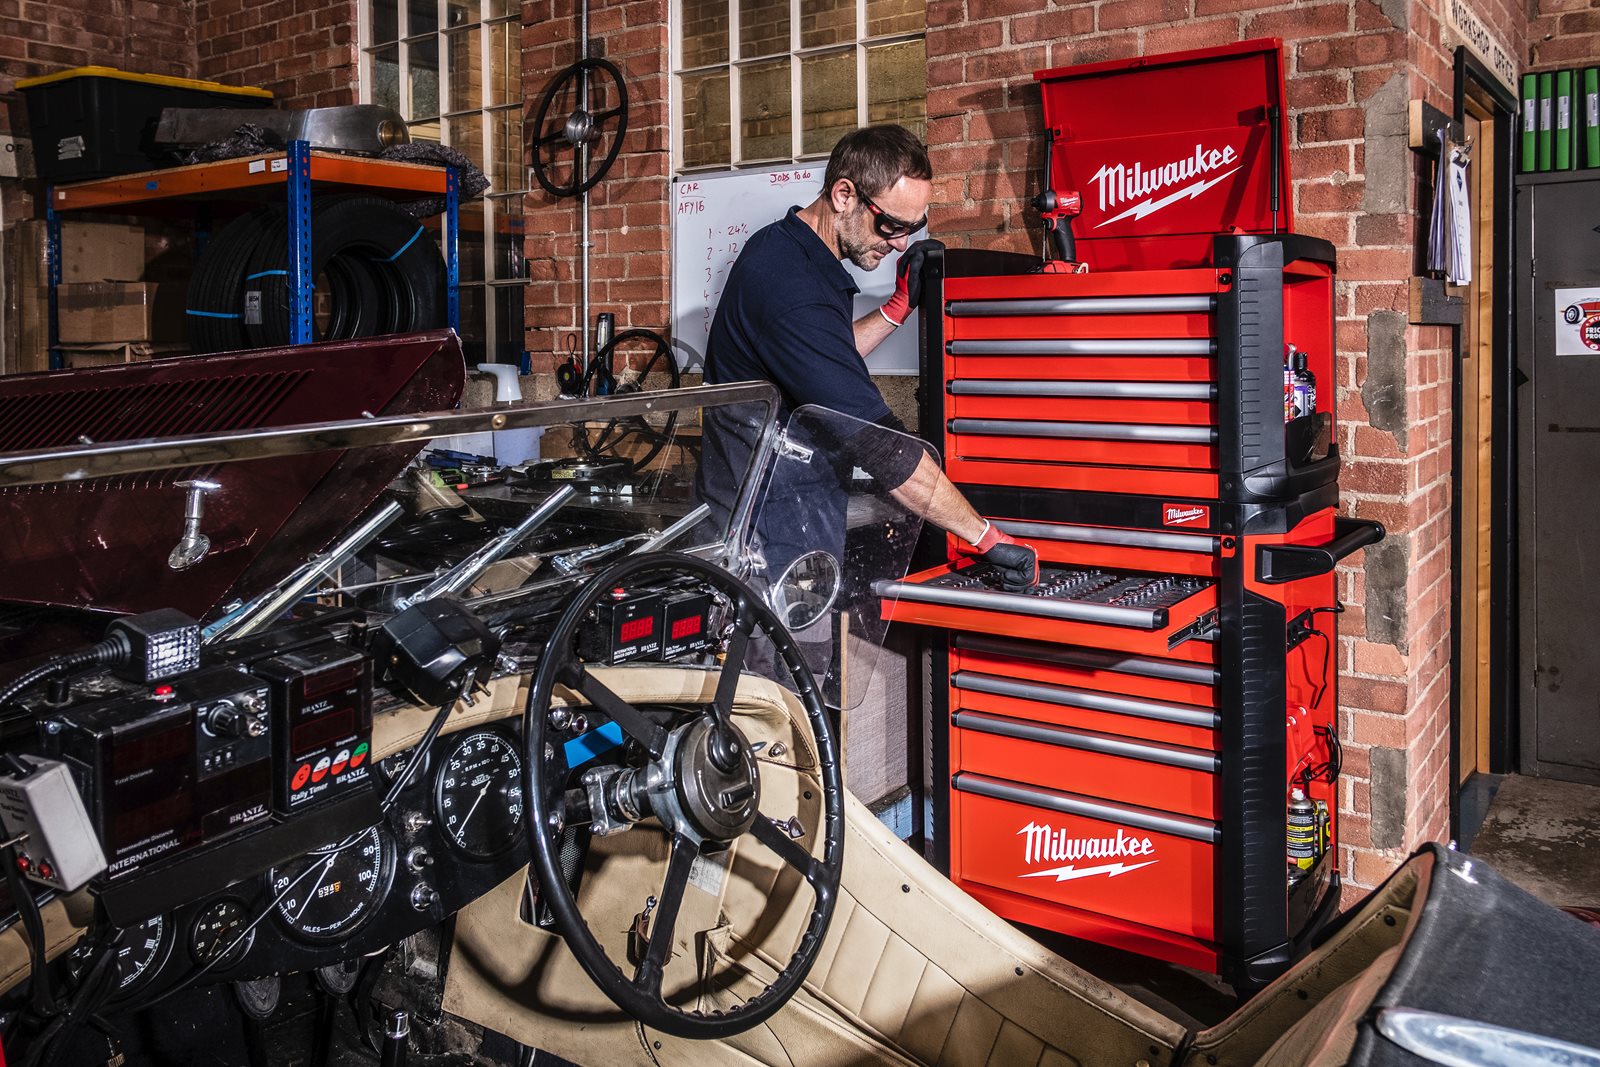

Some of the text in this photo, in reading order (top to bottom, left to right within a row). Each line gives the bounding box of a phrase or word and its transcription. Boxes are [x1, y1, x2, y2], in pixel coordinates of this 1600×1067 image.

[1451, 0, 1514, 86] WORKSHOP OFFICE
[1087, 144, 1238, 212] Milwaukee
[680, 182, 700, 195] CAR
[705, 267, 712, 283] 3
[703, 289, 710, 301] 4
[703, 306, 710, 319] 5
[1166, 507, 1204, 520] Milwaukee
[301, 700, 328, 715] BRANTZ
[462, 745, 472, 757] 30
[476, 740, 486, 751] 35
[491, 744, 499, 753] 40
[451, 760, 461, 770] 25
[501, 754, 509, 763] 45
[336, 767, 367, 785] BRANTZ
[508, 768, 518, 779] 50
[445, 778, 455, 789] 20
[290, 789, 309, 803] Rally
[309, 783, 329, 796] Timer
[510, 786, 520, 797] 55
[443, 798, 452, 808] 15
[508, 804, 518, 814] 60
[229, 803, 264, 825] BRANTZ
[449, 815, 457, 825] 10
[1016, 821, 1156, 865] Milwaukee
[108, 837, 181, 874] INTERNATIONAL
[363, 845, 375, 857] 90
[358, 869, 372, 883] 100
[277, 876, 290, 890] 20
[286, 898, 297, 911] 10
